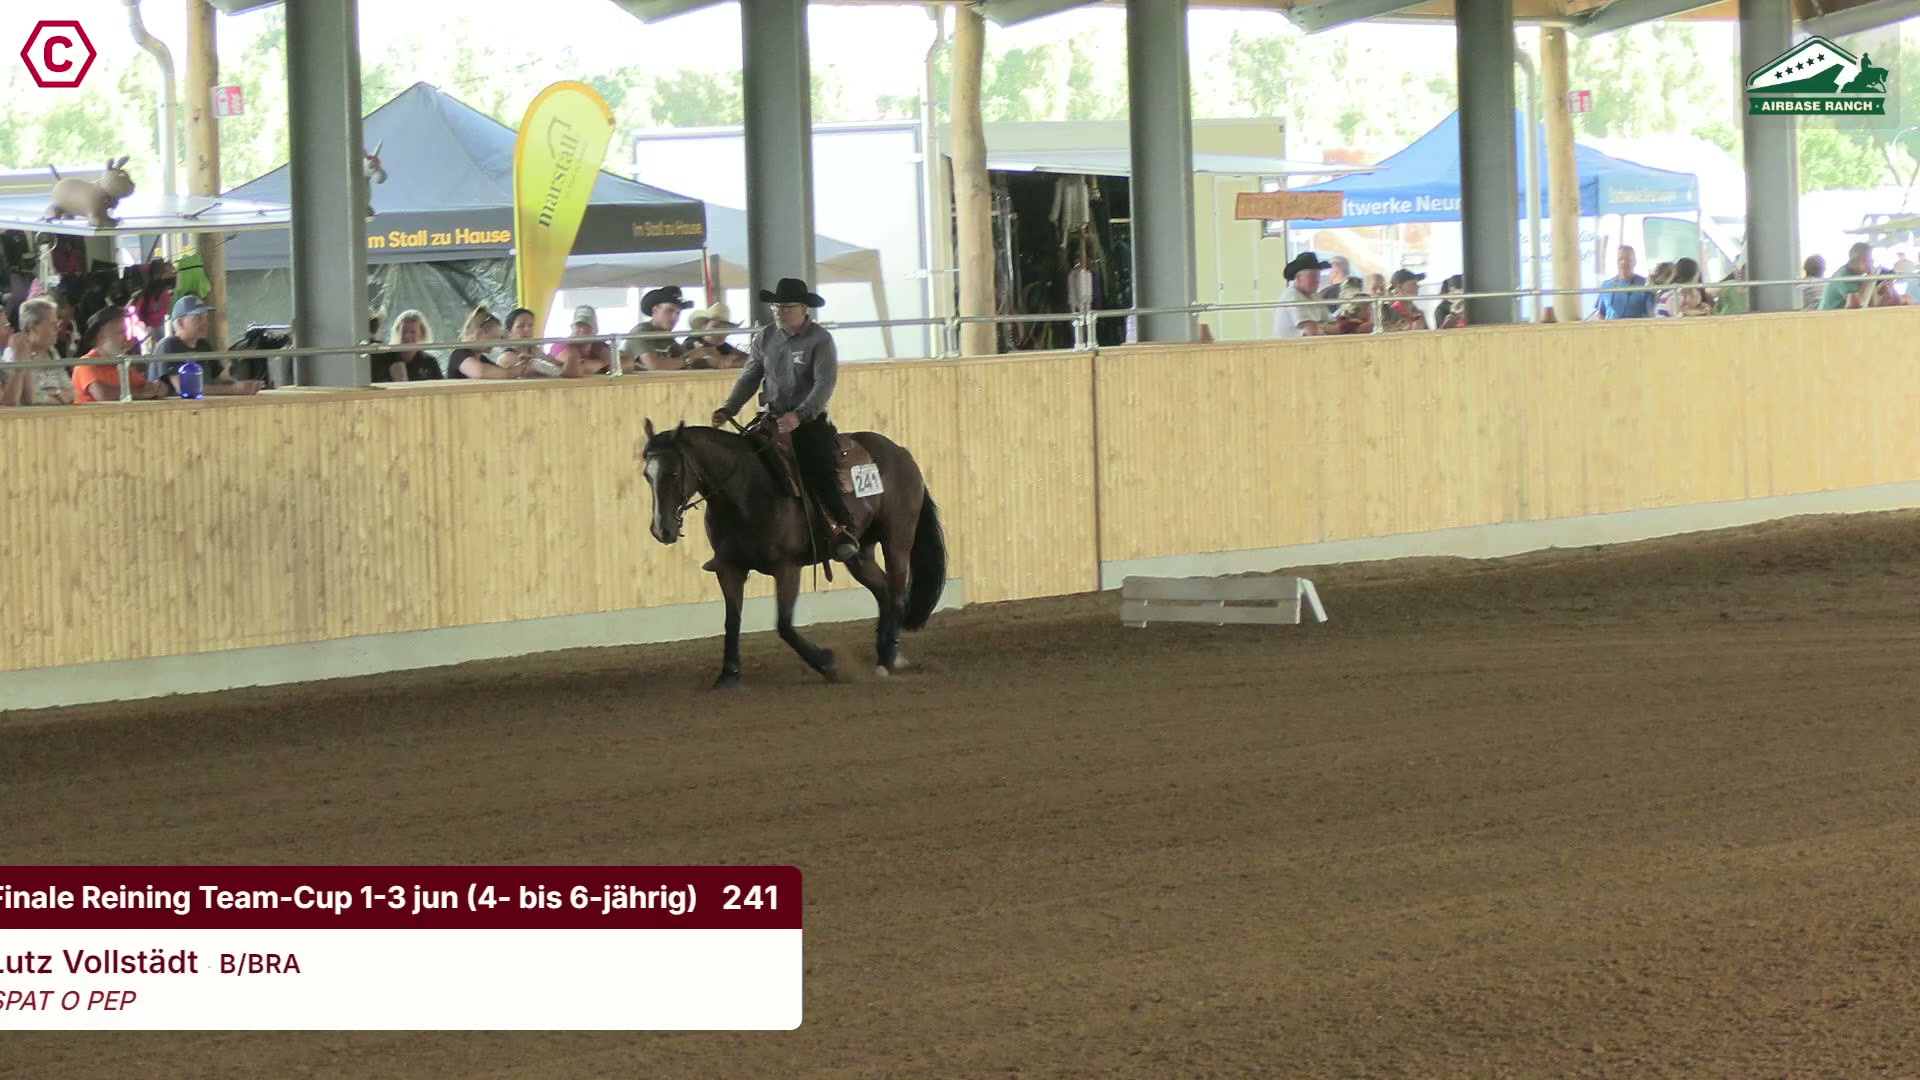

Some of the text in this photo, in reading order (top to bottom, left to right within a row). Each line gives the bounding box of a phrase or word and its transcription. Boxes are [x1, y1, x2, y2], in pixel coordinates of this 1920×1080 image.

[539, 133, 578, 228] marstall
[388, 230, 428, 248] Stall
[430, 233, 451, 246] zu
[455, 228, 511, 245] Hause
[855, 472, 879, 492] 241
